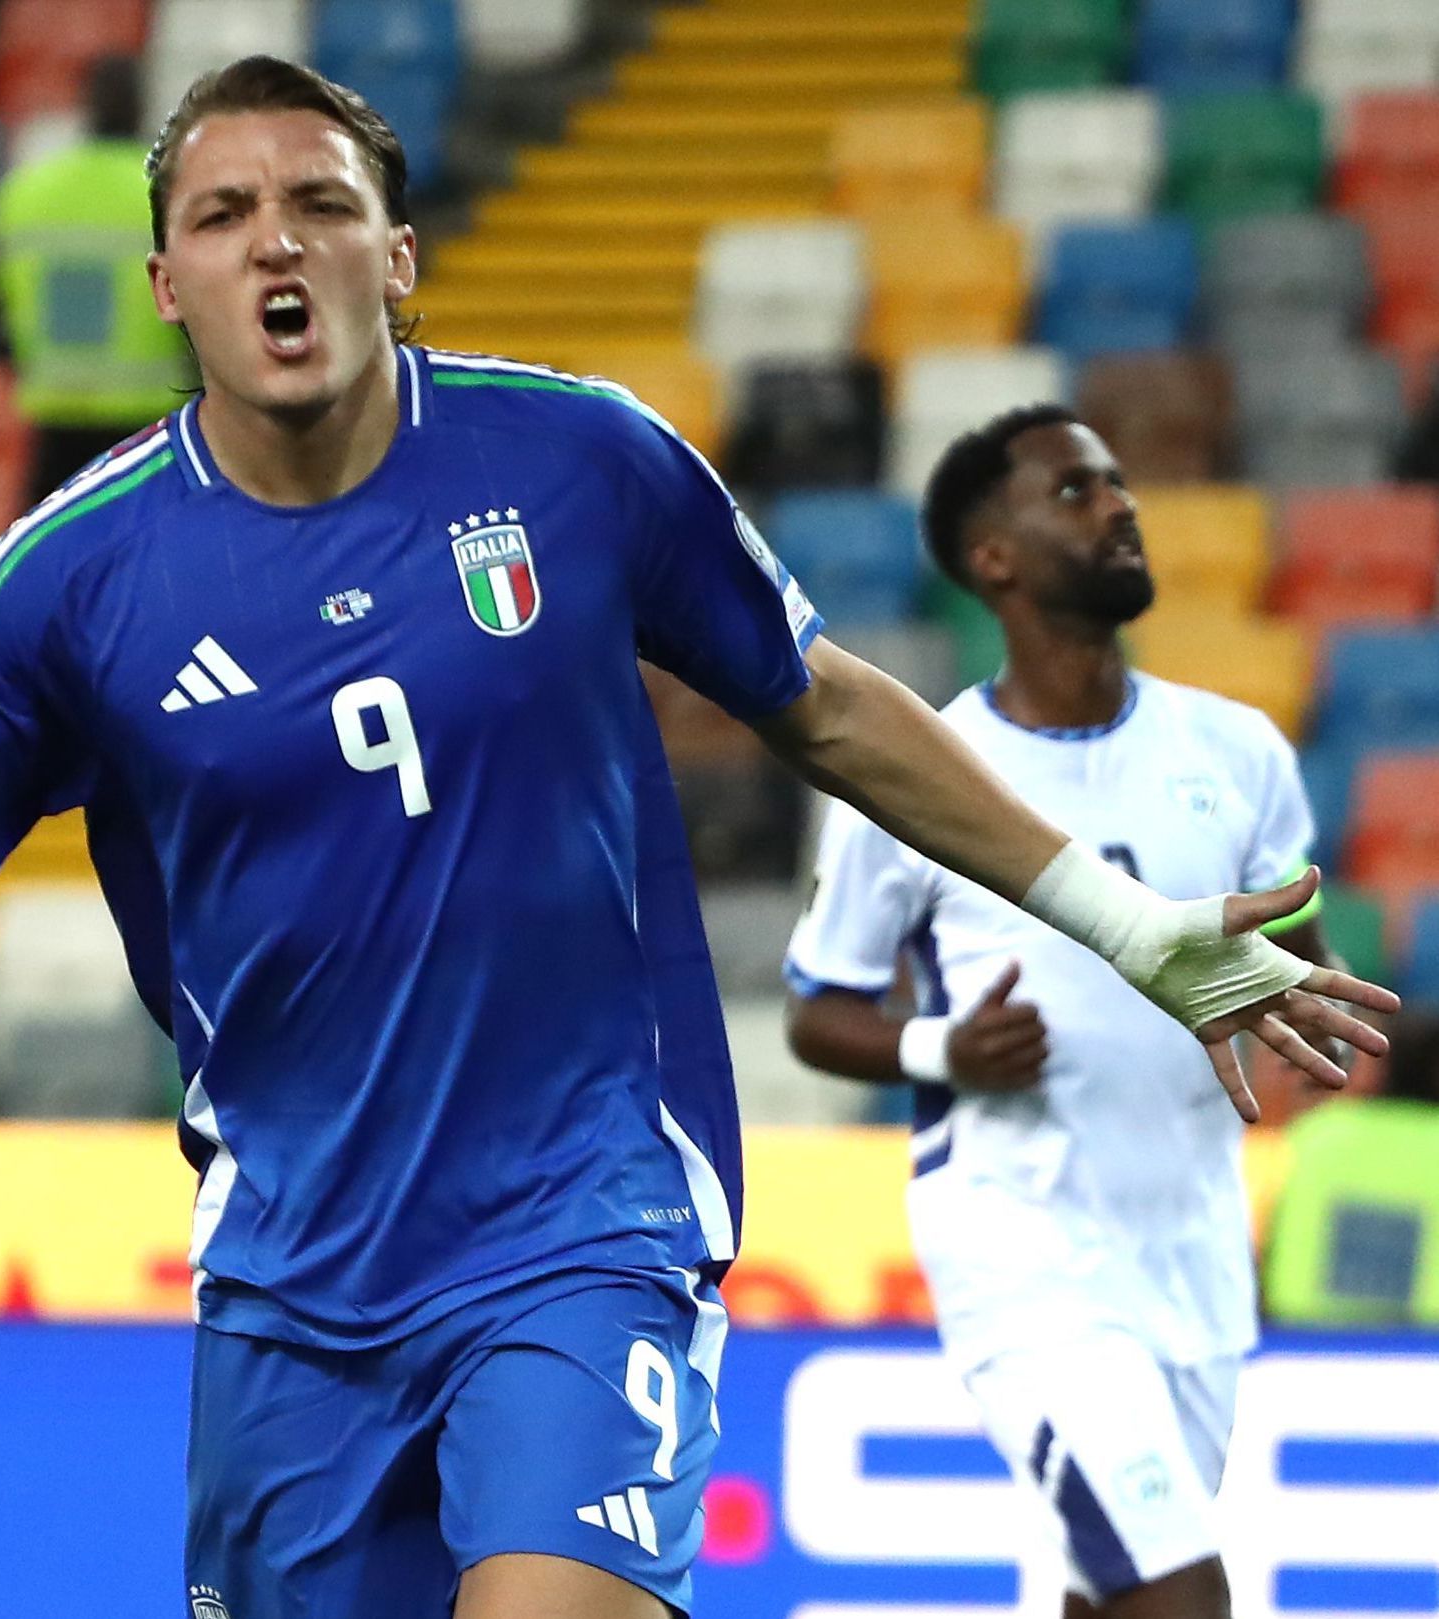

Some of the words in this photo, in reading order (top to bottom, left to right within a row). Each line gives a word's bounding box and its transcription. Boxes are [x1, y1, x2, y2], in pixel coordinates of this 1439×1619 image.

[459, 532, 522, 565] ITALIA
[331, 676, 432, 818] 9
[625, 1338, 679, 1481] 9
